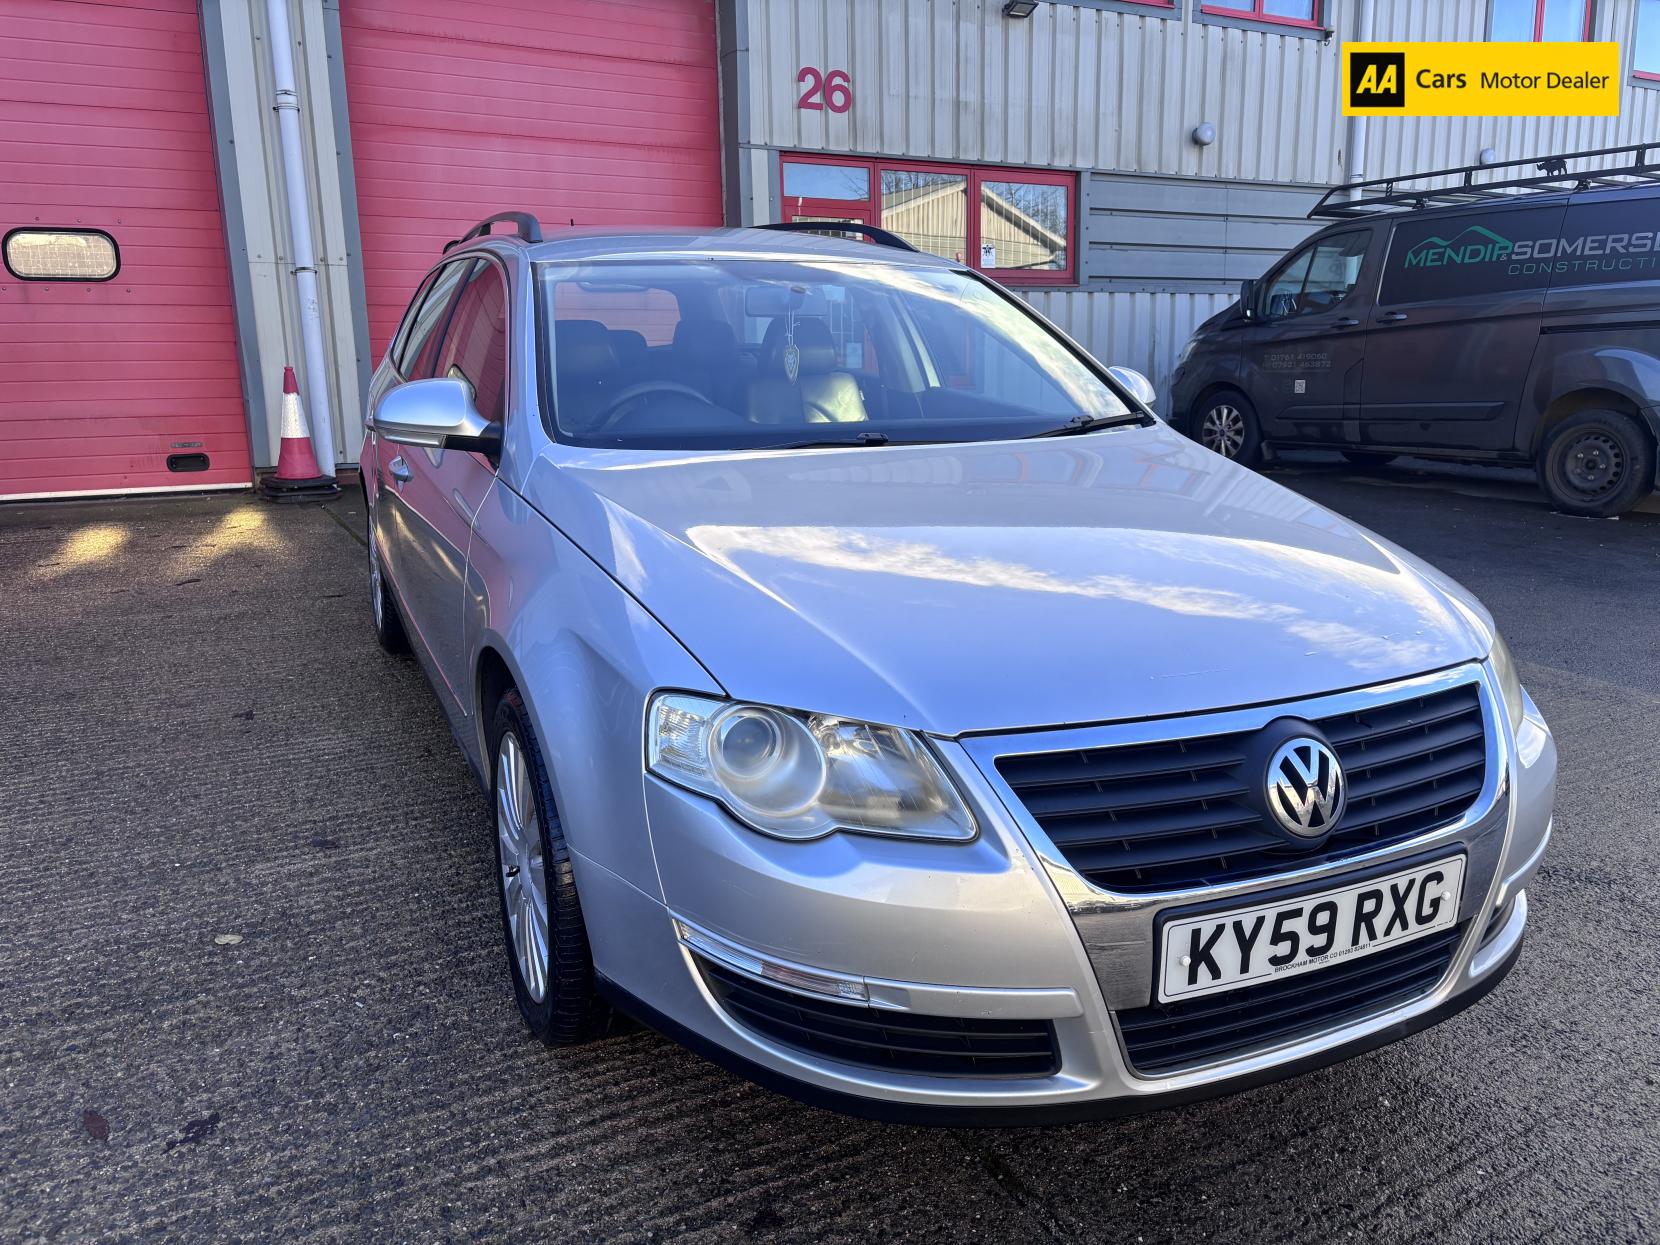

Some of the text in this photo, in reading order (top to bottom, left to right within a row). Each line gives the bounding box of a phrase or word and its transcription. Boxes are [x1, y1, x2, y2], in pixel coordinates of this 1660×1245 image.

[798, 67, 852, 113] 26
[1404, 241, 1513, 269] MENDIP
[1511, 231, 1660, 260] SOMERS
[1187, 871, 1444, 985] KY59 RXG
[1274, 959, 1308, 973] BROCKHAM
[1308, 954, 1329, 965] MOTOR
